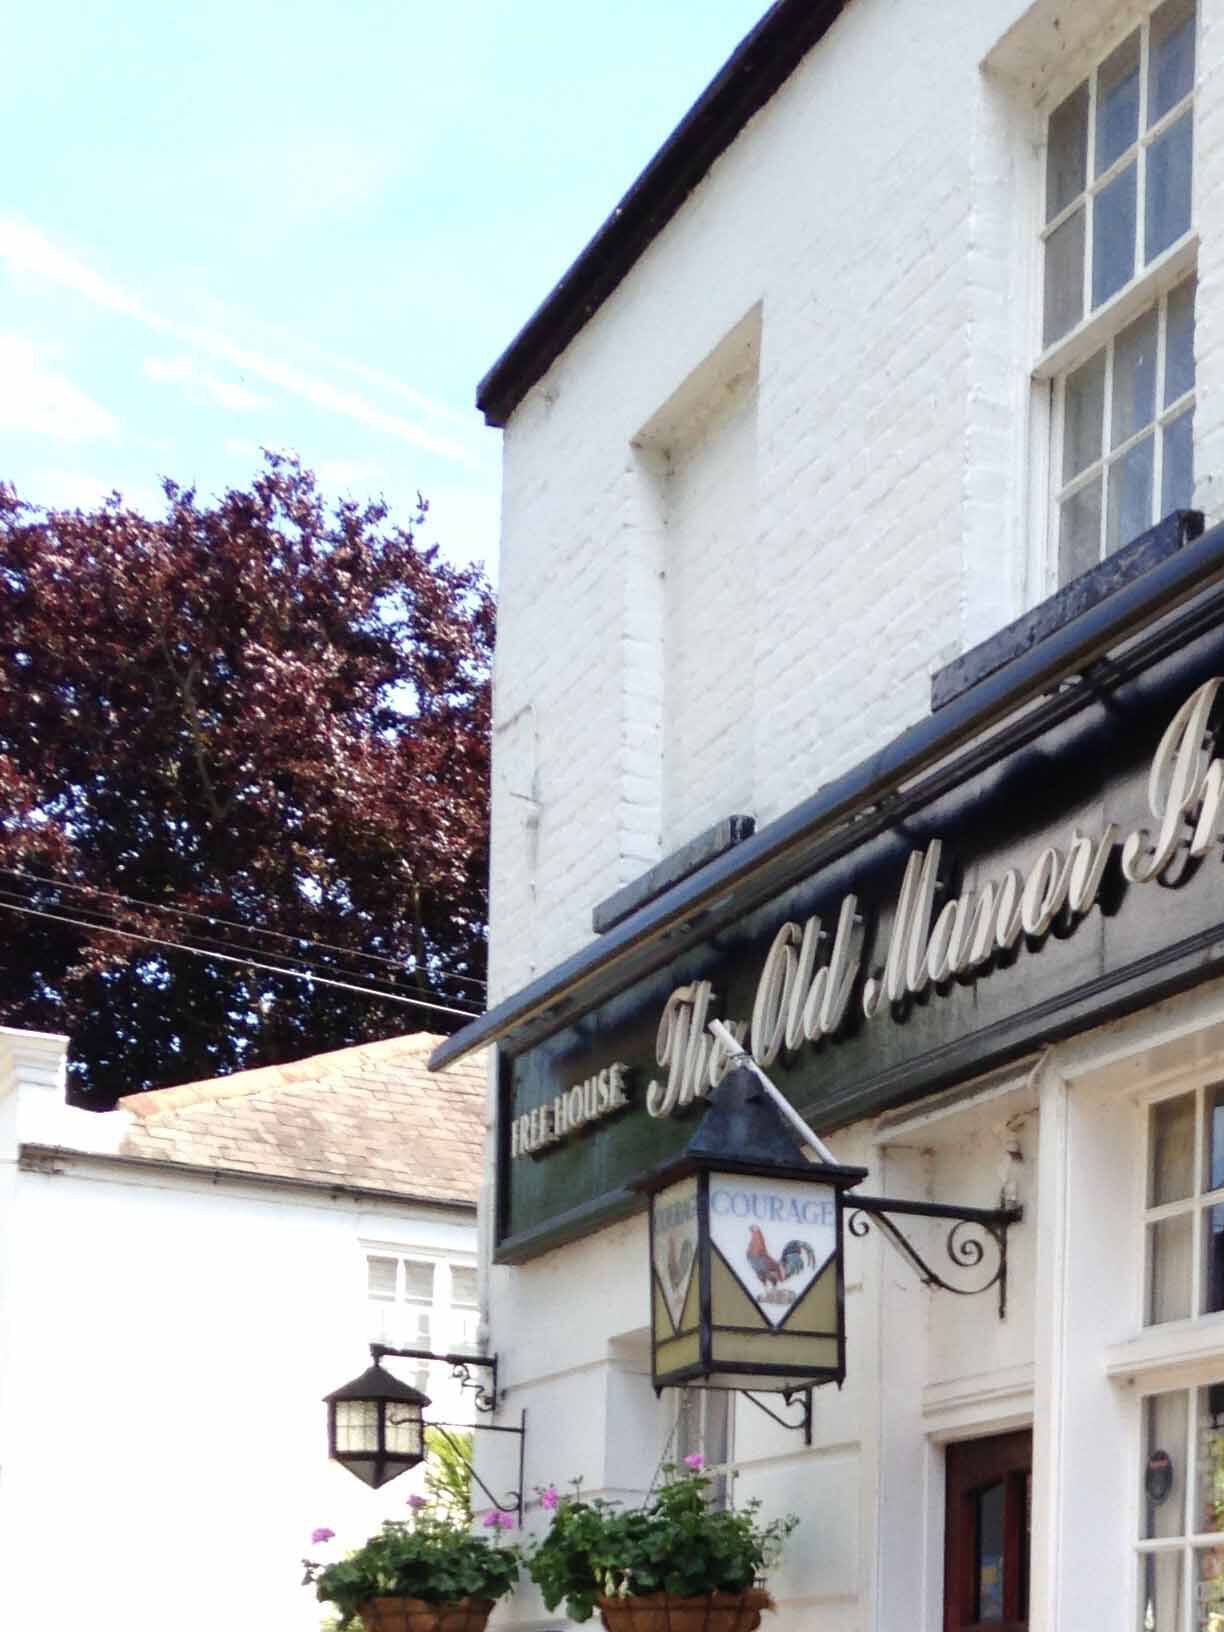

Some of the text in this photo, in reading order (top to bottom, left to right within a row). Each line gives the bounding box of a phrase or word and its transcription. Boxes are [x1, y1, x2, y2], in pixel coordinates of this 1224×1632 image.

[646, 980, 749, 1118] The
[751, 892, 865, 1069] Old
[863, 838, 1117, 1018] Manor
[511, 1061, 630, 1159] FREE HOUSE
[710, 1189, 834, 1227] COURAGE
